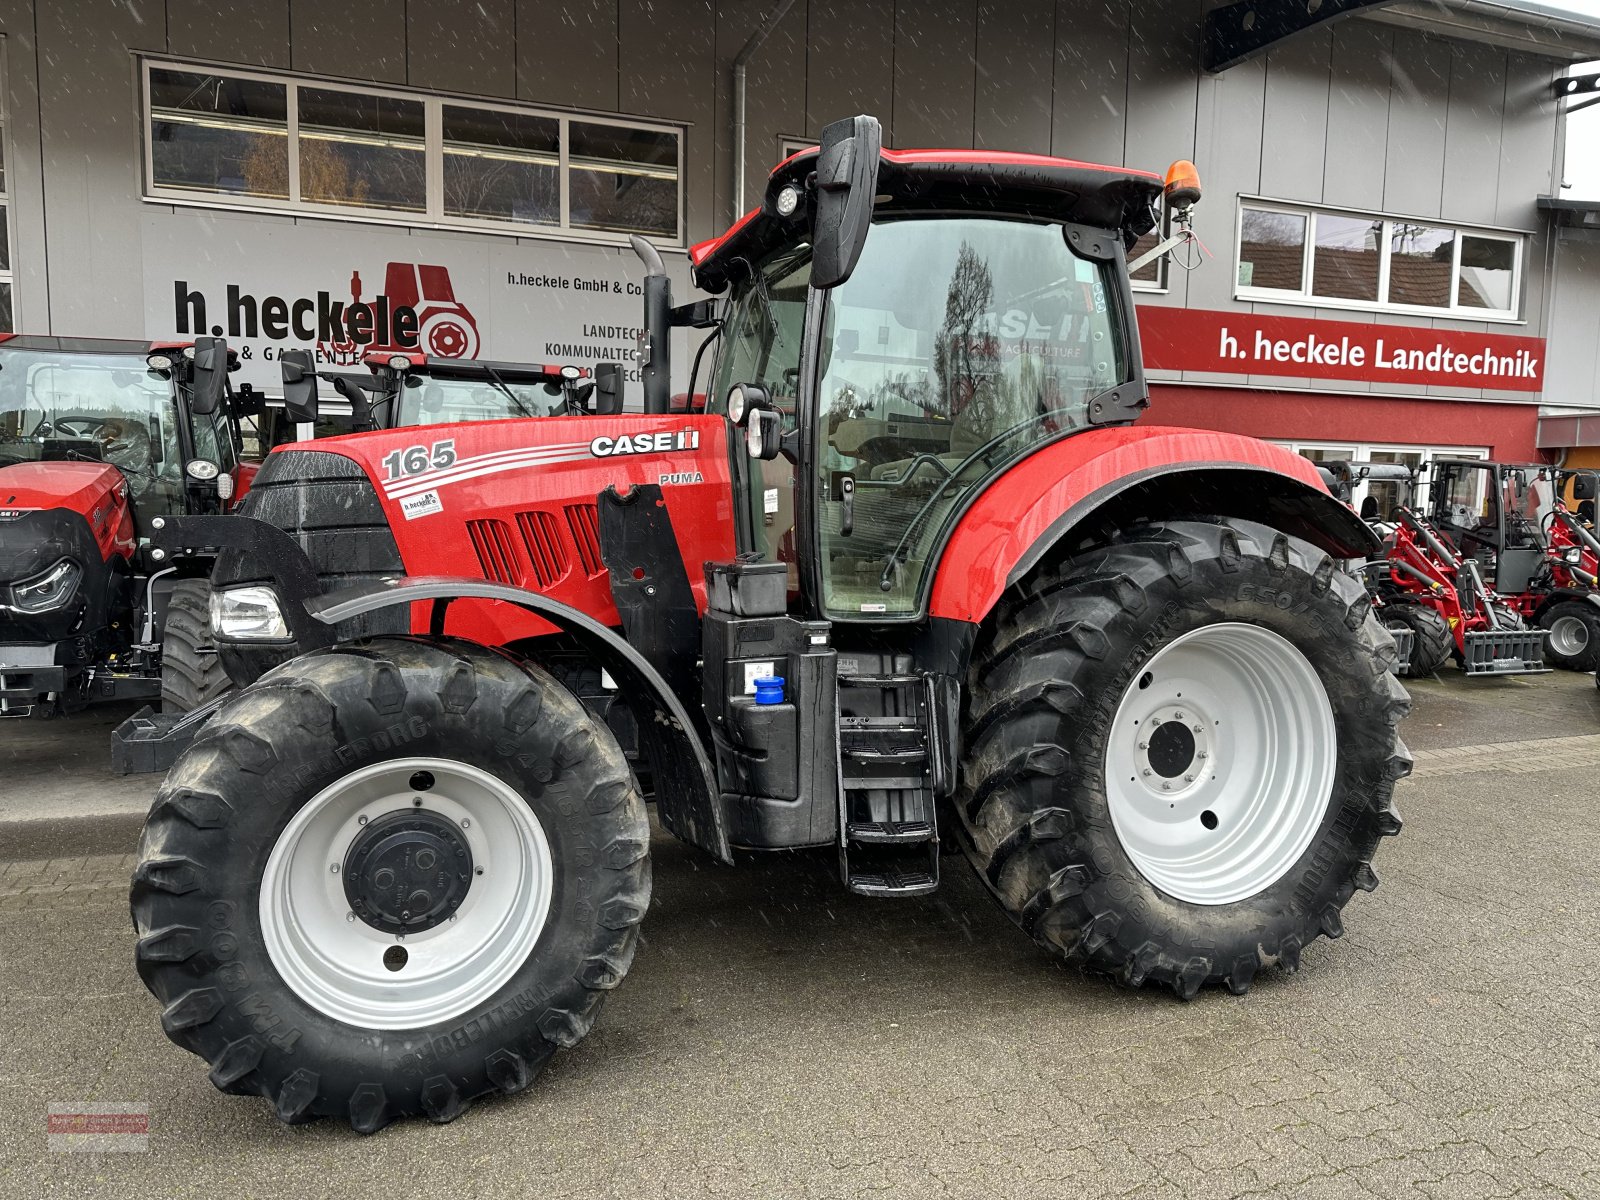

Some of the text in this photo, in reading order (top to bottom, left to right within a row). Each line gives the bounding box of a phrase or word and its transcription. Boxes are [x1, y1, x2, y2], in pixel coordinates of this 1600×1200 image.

[507, 272, 645, 296] h.heckele GmbH & Co.
[174, 280, 420, 347] h.heckele
[583, 324, 644, 341] LANDTECH
[241, 345, 253, 361] &
[545, 343, 636, 361] KOMMUNALTEC
[1254, 330, 1366, 367] heckele
[1374, 339, 1538, 378] Landtechnik
[590, 432, 673, 457] CASE
[381, 438, 457, 481] 165
[658, 471, 704, 486] PUMA
[1089, 845, 1152, 924] 800
[205, 899, 303, 1056] TM 800
